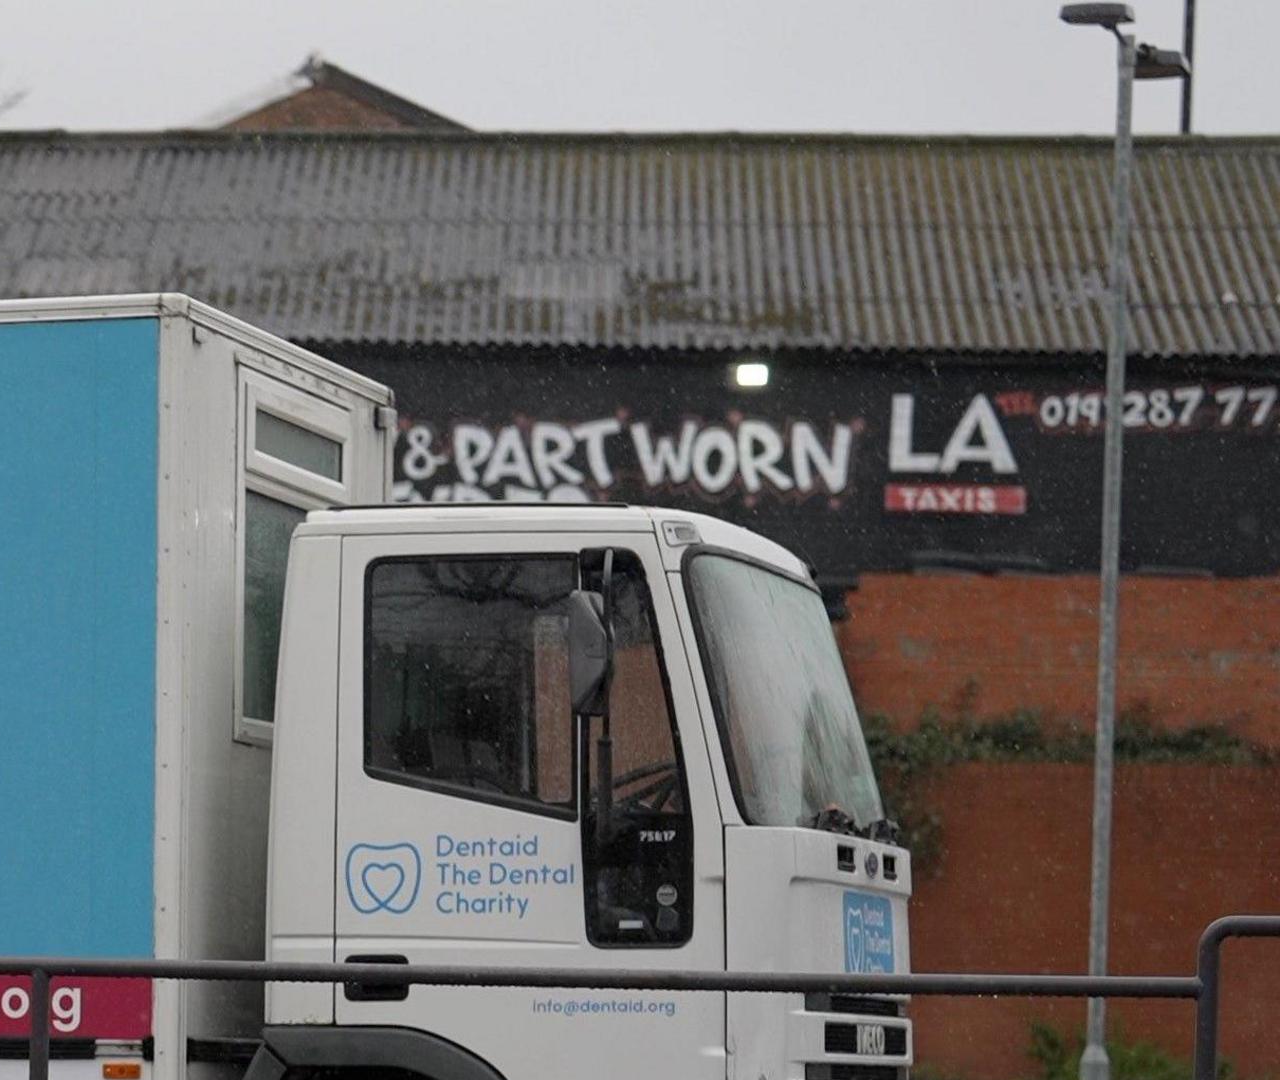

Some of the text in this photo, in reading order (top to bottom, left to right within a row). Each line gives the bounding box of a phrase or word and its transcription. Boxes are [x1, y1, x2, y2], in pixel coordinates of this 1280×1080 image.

[889, 391, 1018, 473] LA
[403, 418, 853, 494] & PART WORN
[898, 486, 997, 512] TAXIS
[435, 834, 538, 857] Dentaid
[435, 862, 575, 886] The Dental
[435, 890, 529, 919] Charity
[532, 999, 676, 1018] info@dentaid.org
